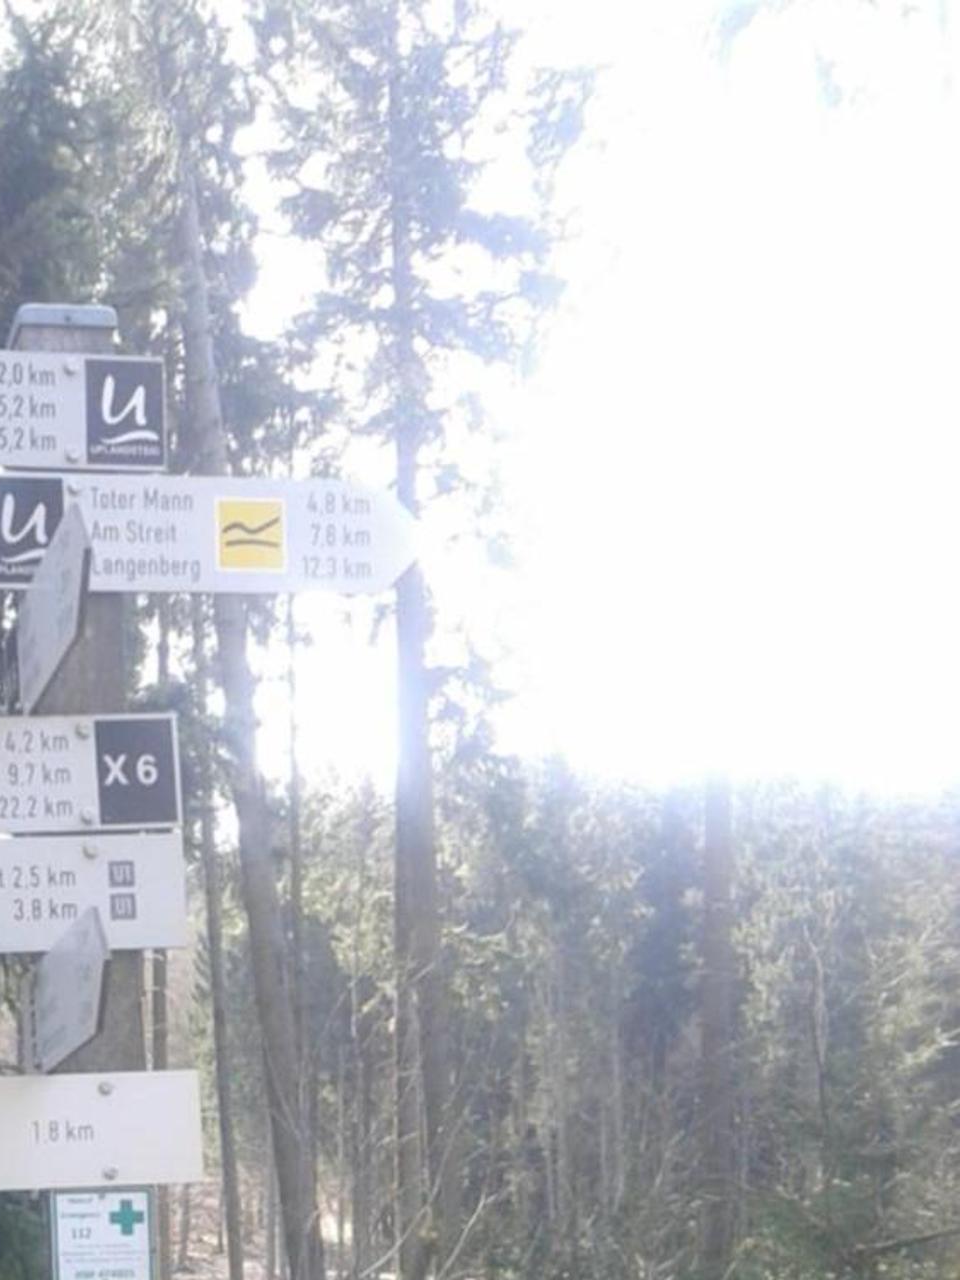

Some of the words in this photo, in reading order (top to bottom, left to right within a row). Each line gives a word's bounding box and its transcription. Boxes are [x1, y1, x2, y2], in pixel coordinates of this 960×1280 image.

[28, 363, 56, 386] km
[29, 396, 56, 418] km
[29, 427, 56, 449] km
[91, 487, 135, 510] Toter
[143, 488, 194, 511] Mann
[306, 491, 336, 517] 4,8
[342, 493, 371, 515] km
[91, 521, 119, 542] Am
[127, 520, 176, 543] Streit
[310, 523, 336, 548] 7,8
[342, 523, 371, 546] km
[91, 554, 201, 581] Langenberg
[343, 557, 372, 578] km
[5, 731, 34, 753] 4,2
[40, 731, 69, 751] km
[7, 763, 35, 786] 9,7
[42, 764, 71, 784] km
[44, 796, 73, 817] km
[13, 866, 40, 888] 2,5
[48, 866, 76, 887] km
[13, 898, 42, 921] 3,8
[49, 899, 78, 919] km
[65, 1119, 94, 1142] km
